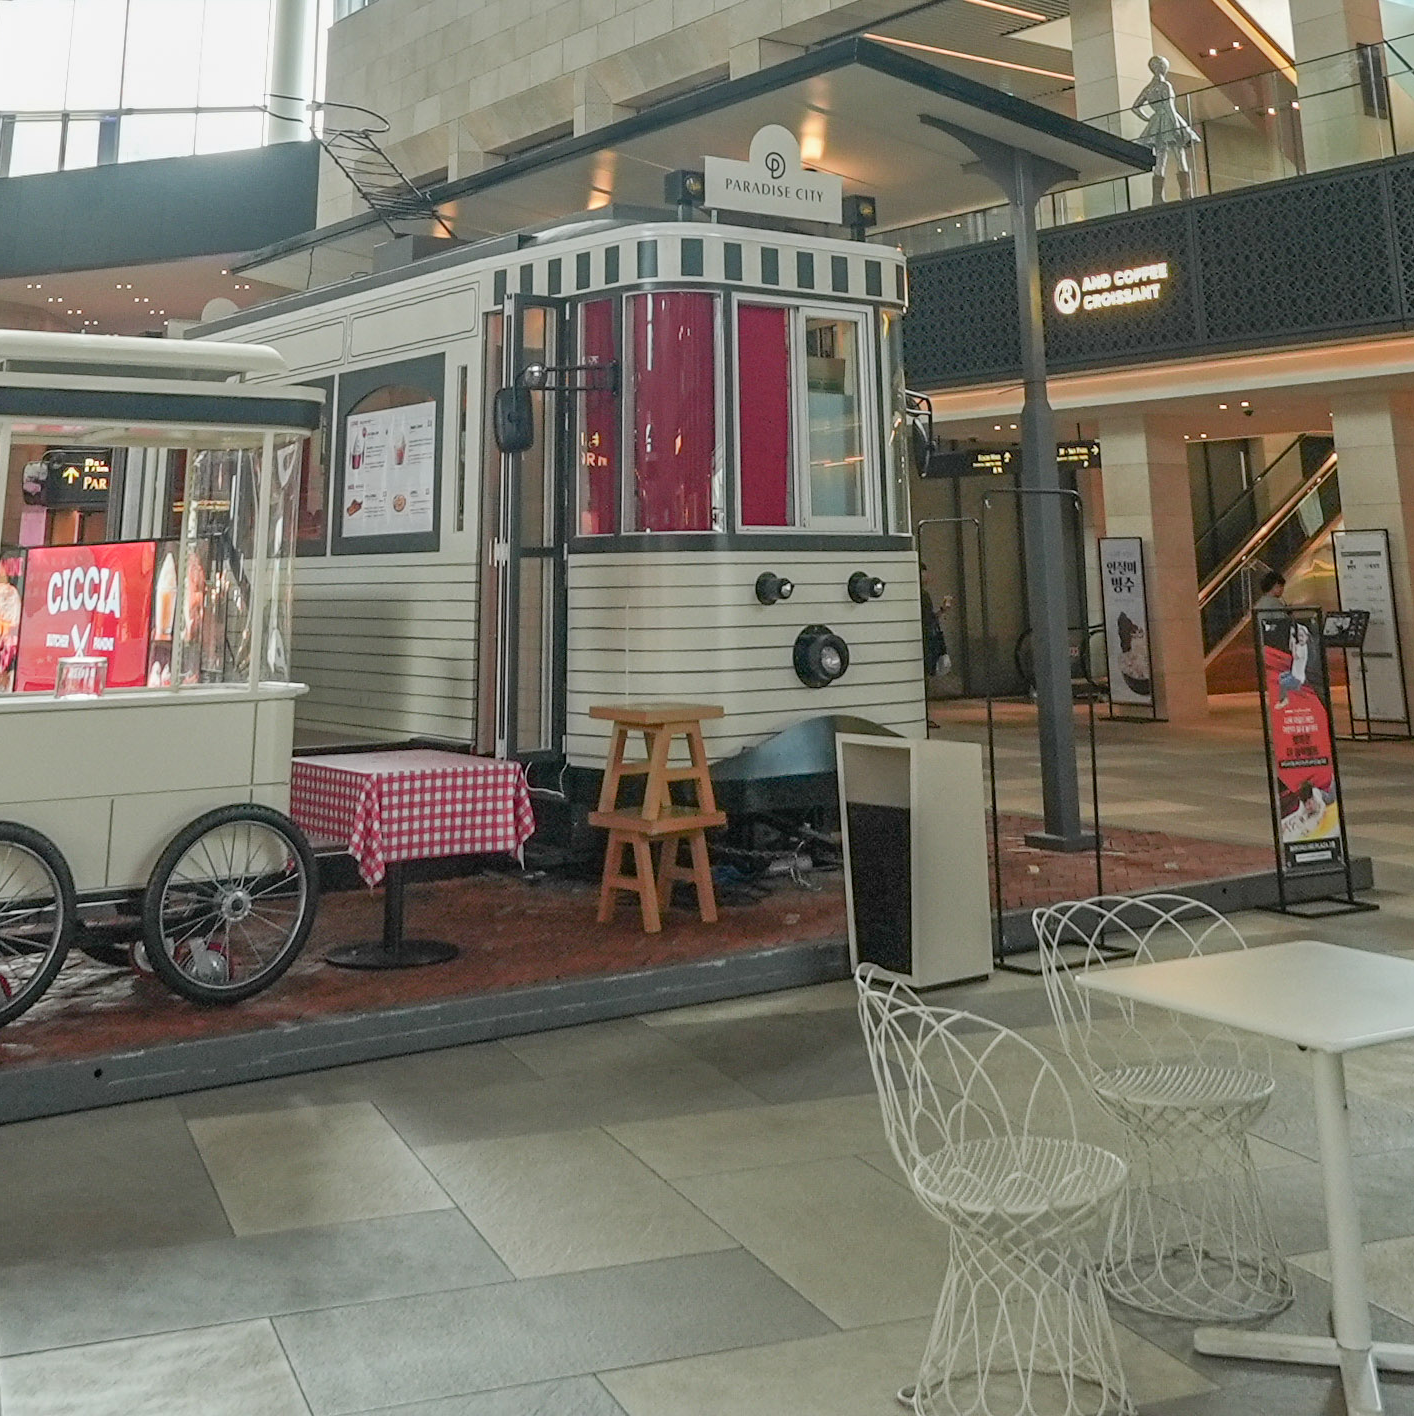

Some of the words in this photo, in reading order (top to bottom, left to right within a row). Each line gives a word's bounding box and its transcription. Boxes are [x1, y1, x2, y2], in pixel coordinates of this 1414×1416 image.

[725, 178, 791, 199] PARADISE
[795, 188, 824, 203] CITY
[1082, 273, 1112, 292] AND
[1113, 262, 1168, 286] COFFEE
[1083, 283, 1161, 311] CROISSANT
[46, 565, 122, 619] CICCIA
